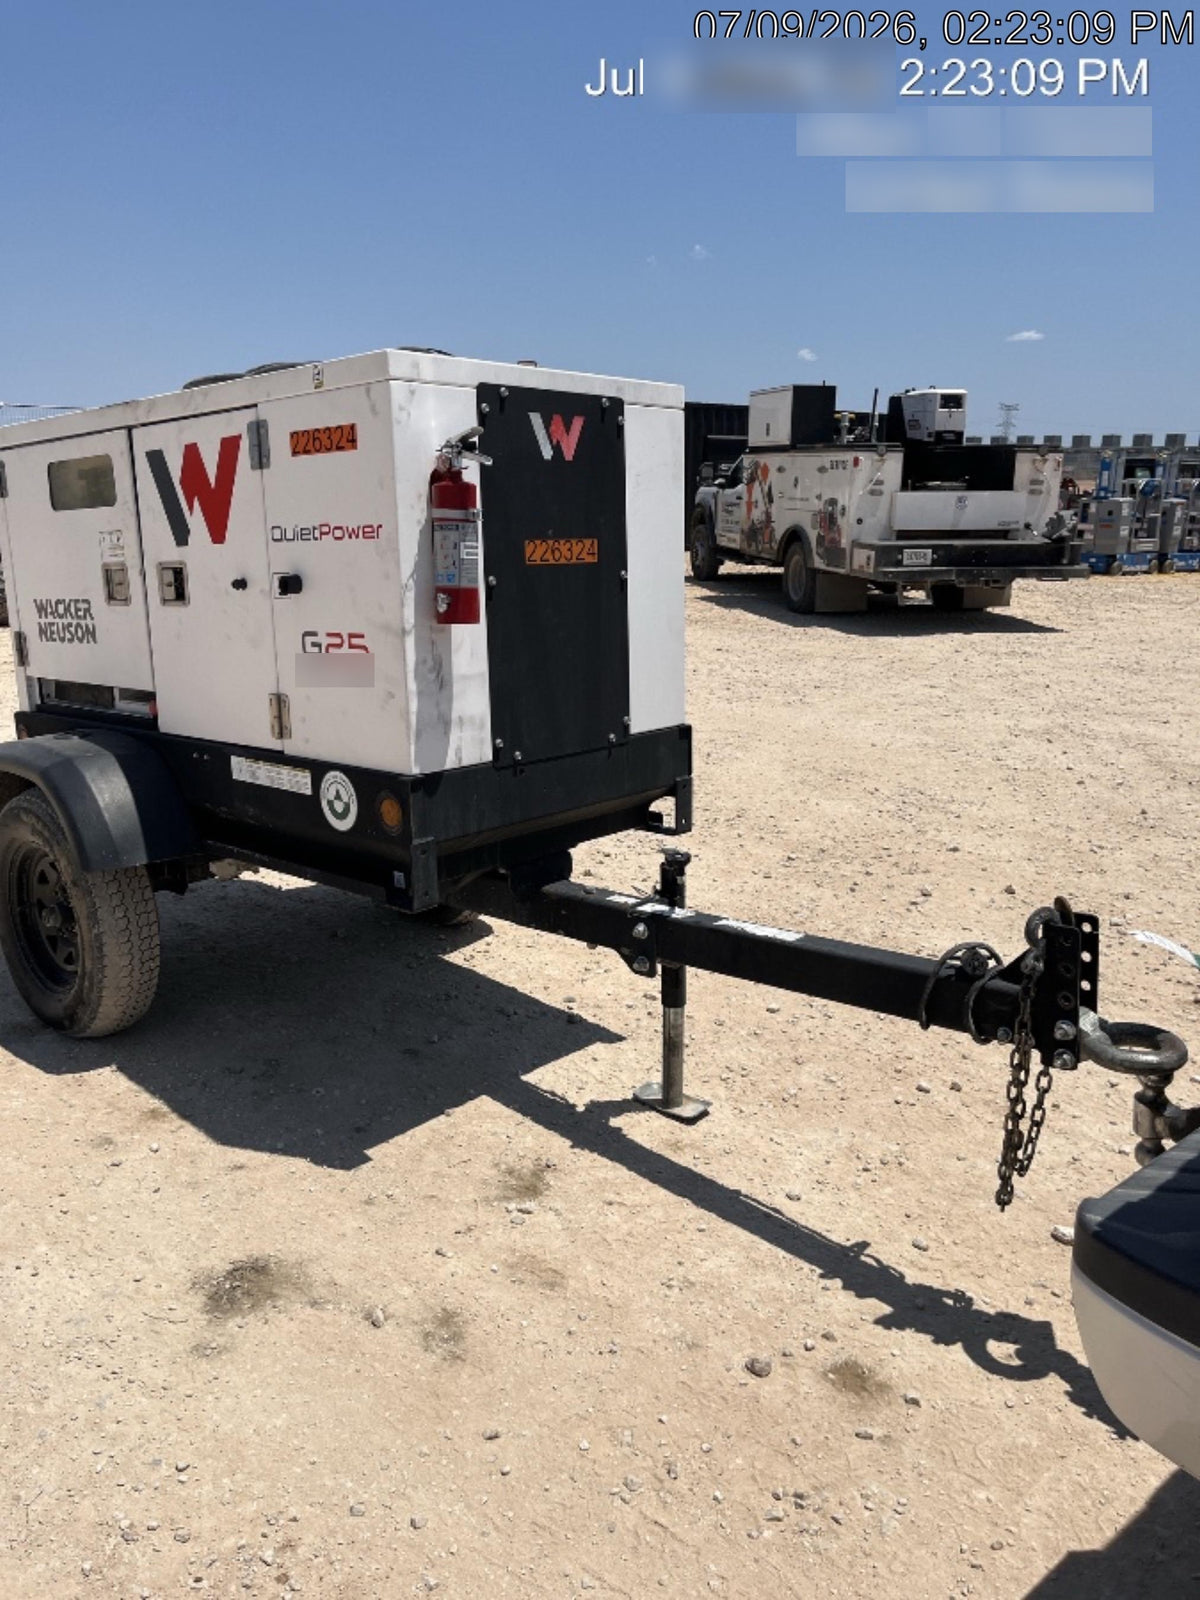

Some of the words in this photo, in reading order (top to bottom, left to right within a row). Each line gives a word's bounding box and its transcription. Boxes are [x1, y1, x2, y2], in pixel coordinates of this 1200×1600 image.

[290, 423, 357, 457] 226324
[271, 523, 383, 542] QuietPower
[527, 540, 597, 562] 226324
[33, 598, 95, 621] WACKER
[38, 622, 97, 644] NEUSON
